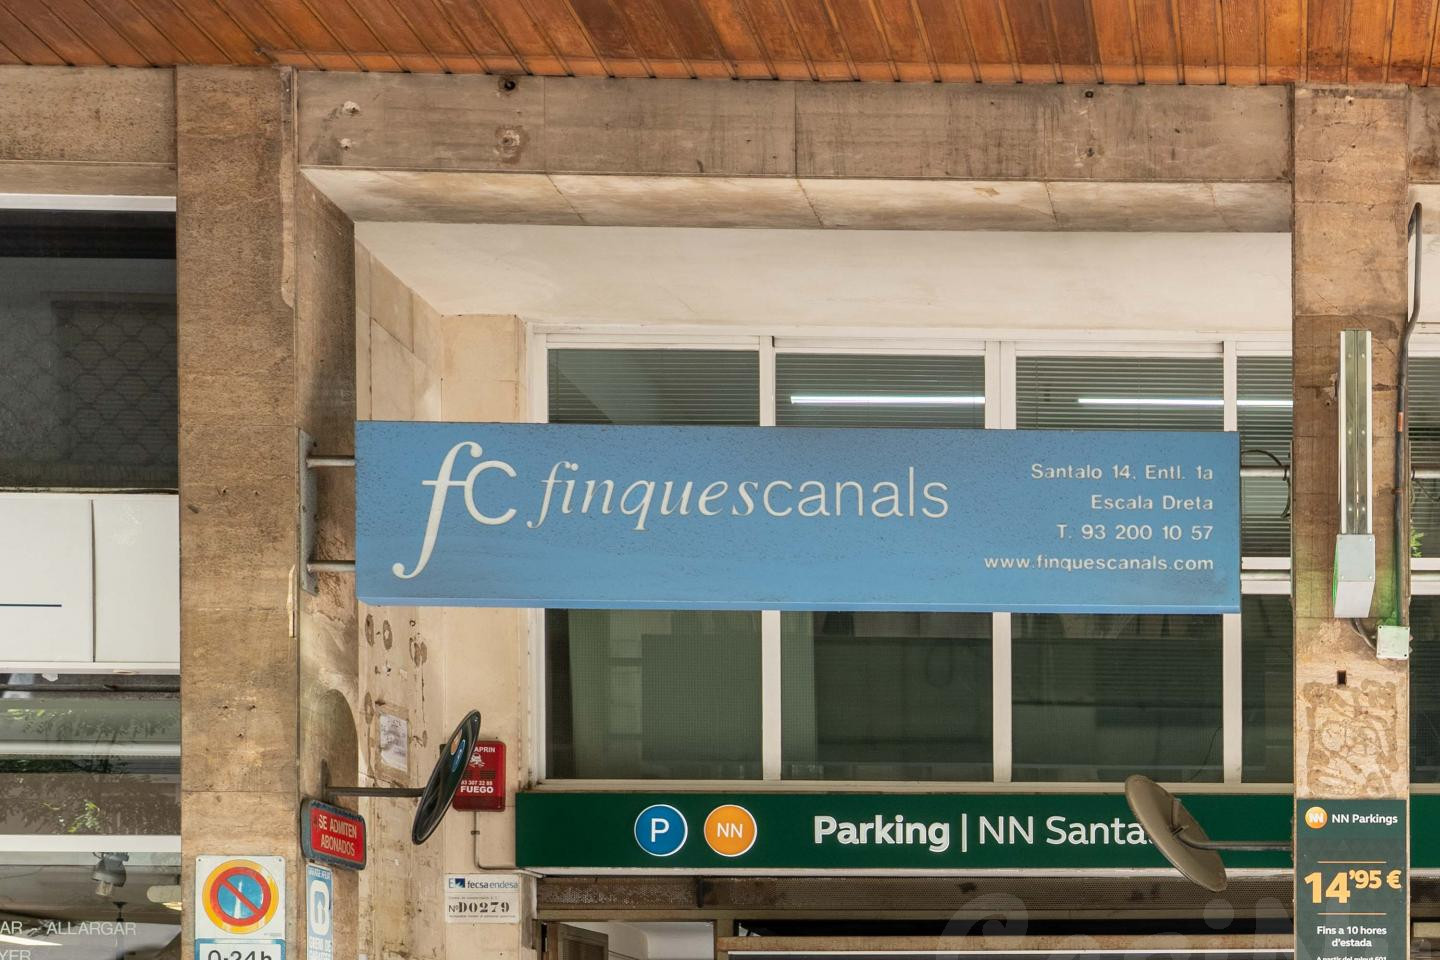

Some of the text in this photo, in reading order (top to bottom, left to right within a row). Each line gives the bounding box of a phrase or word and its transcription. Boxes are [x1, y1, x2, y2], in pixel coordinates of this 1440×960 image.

[1031, 463, 1102, 480] Santalo
[1145, 464, 1185, 480] Entl.
[1196, 465, 1213, 480] 1a
[1091, 494, 1213, 510] Escala Dreta
[1056, 523, 1213, 540] T. 93 200 10 57
[984, 554, 1214, 572] www.finquescanals.com
[460, 786, 494, 794] FUEGO
[318, 814, 357, 838] SE ADMITEN
[1332, 813, 1398, 826] NN Parkings
[650, 818, 671, 843] P
[716, 822, 744, 838] NN
[814, 814, 1152, 852] Parking NN Santa
[321, 834, 355, 856] ABONADOS
[1386, 870, 1402, 889] €
[46, 922, 137, 935] ALLARGAR
[1316, 926, 1336, 935] Fins
[1347, 926, 1358, 935] 10
[1360, 926, 1387, 935] hores
[1331, 938, 1372, 947] d'estada
